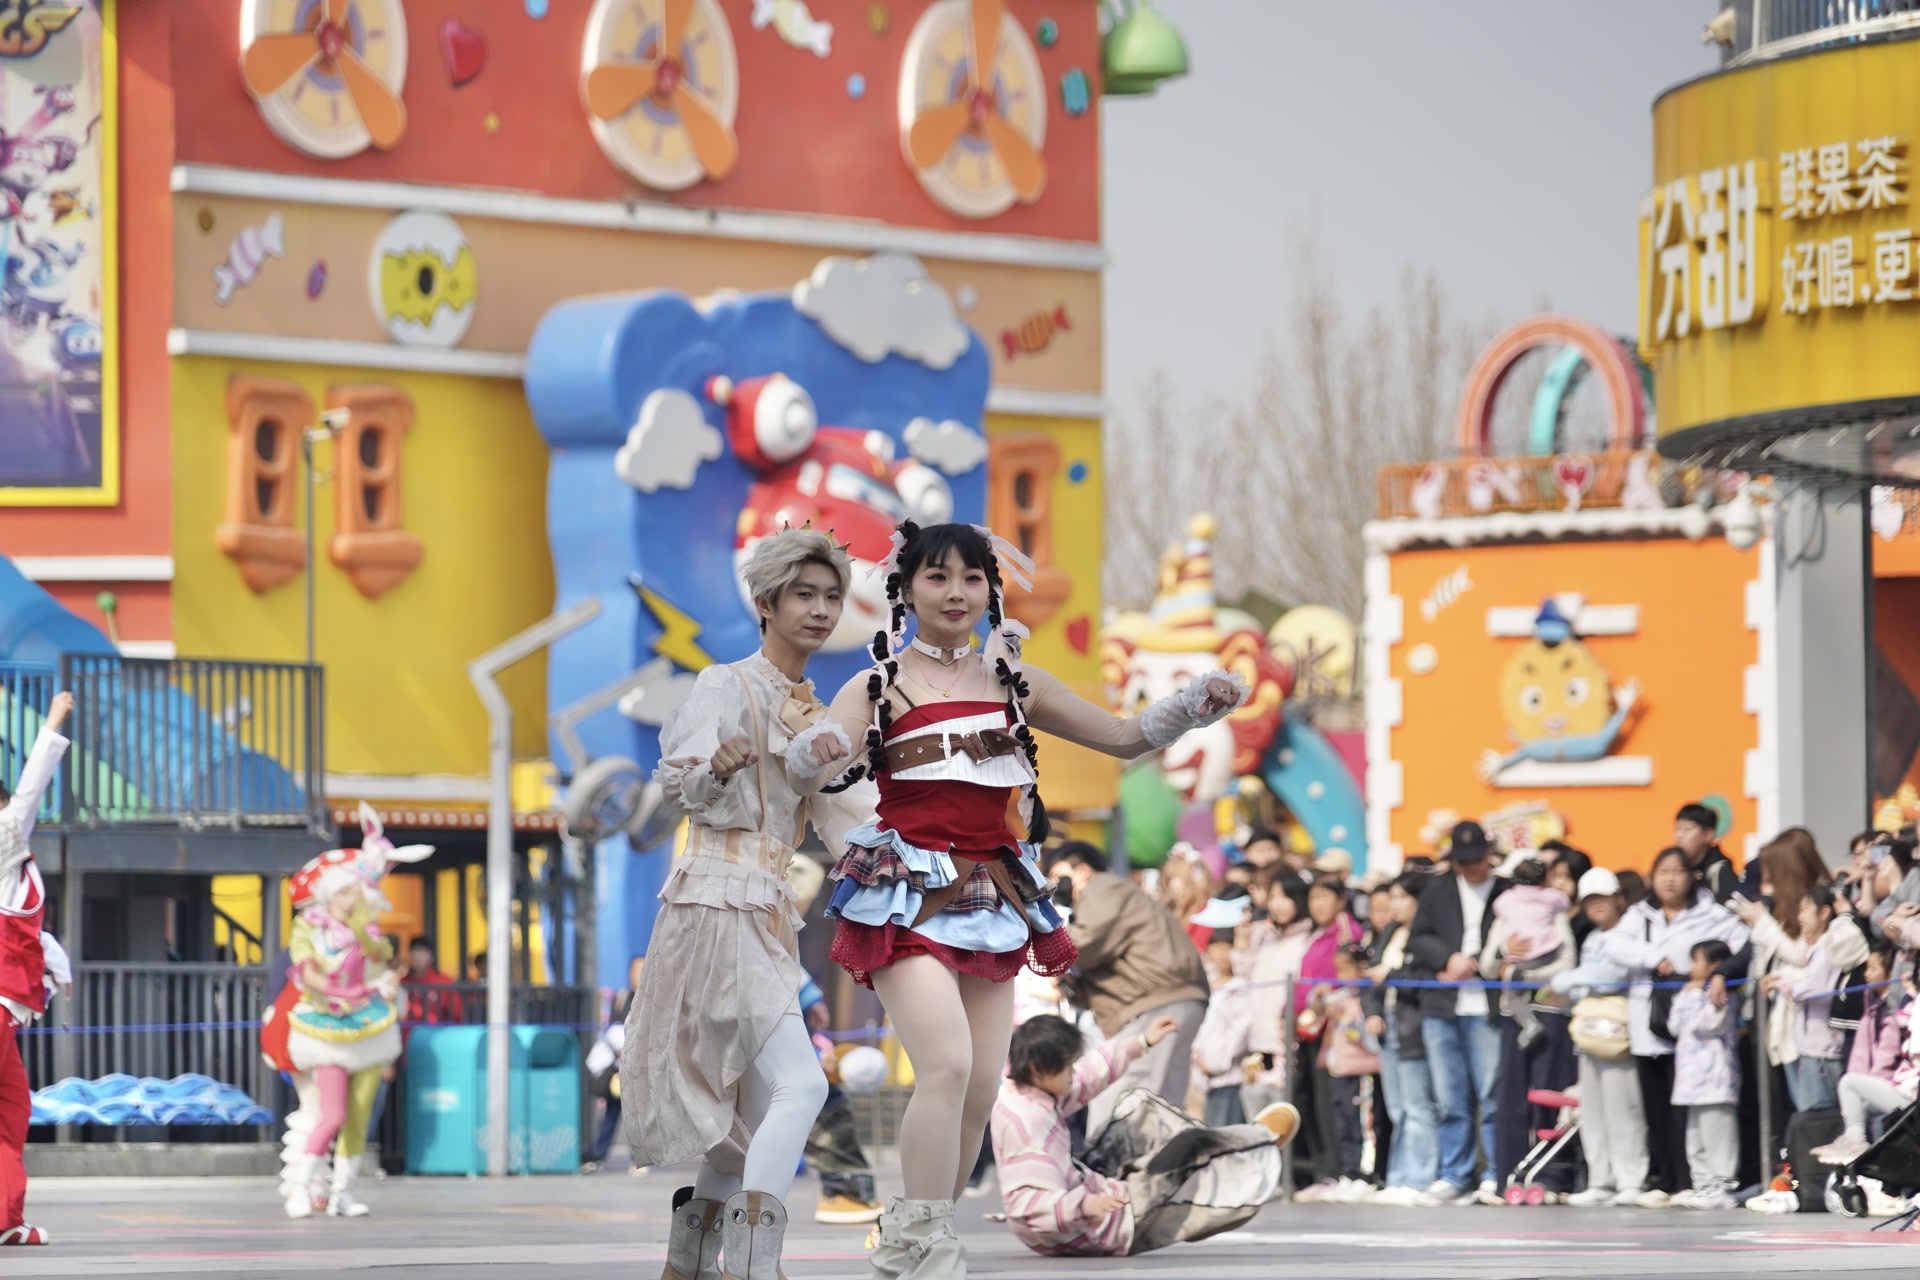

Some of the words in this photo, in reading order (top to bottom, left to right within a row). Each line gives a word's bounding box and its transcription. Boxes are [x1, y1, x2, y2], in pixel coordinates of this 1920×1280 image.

[1780, 136, 1897, 220] 鲜果茶
[1639, 160, 1758, 342] 分甜
